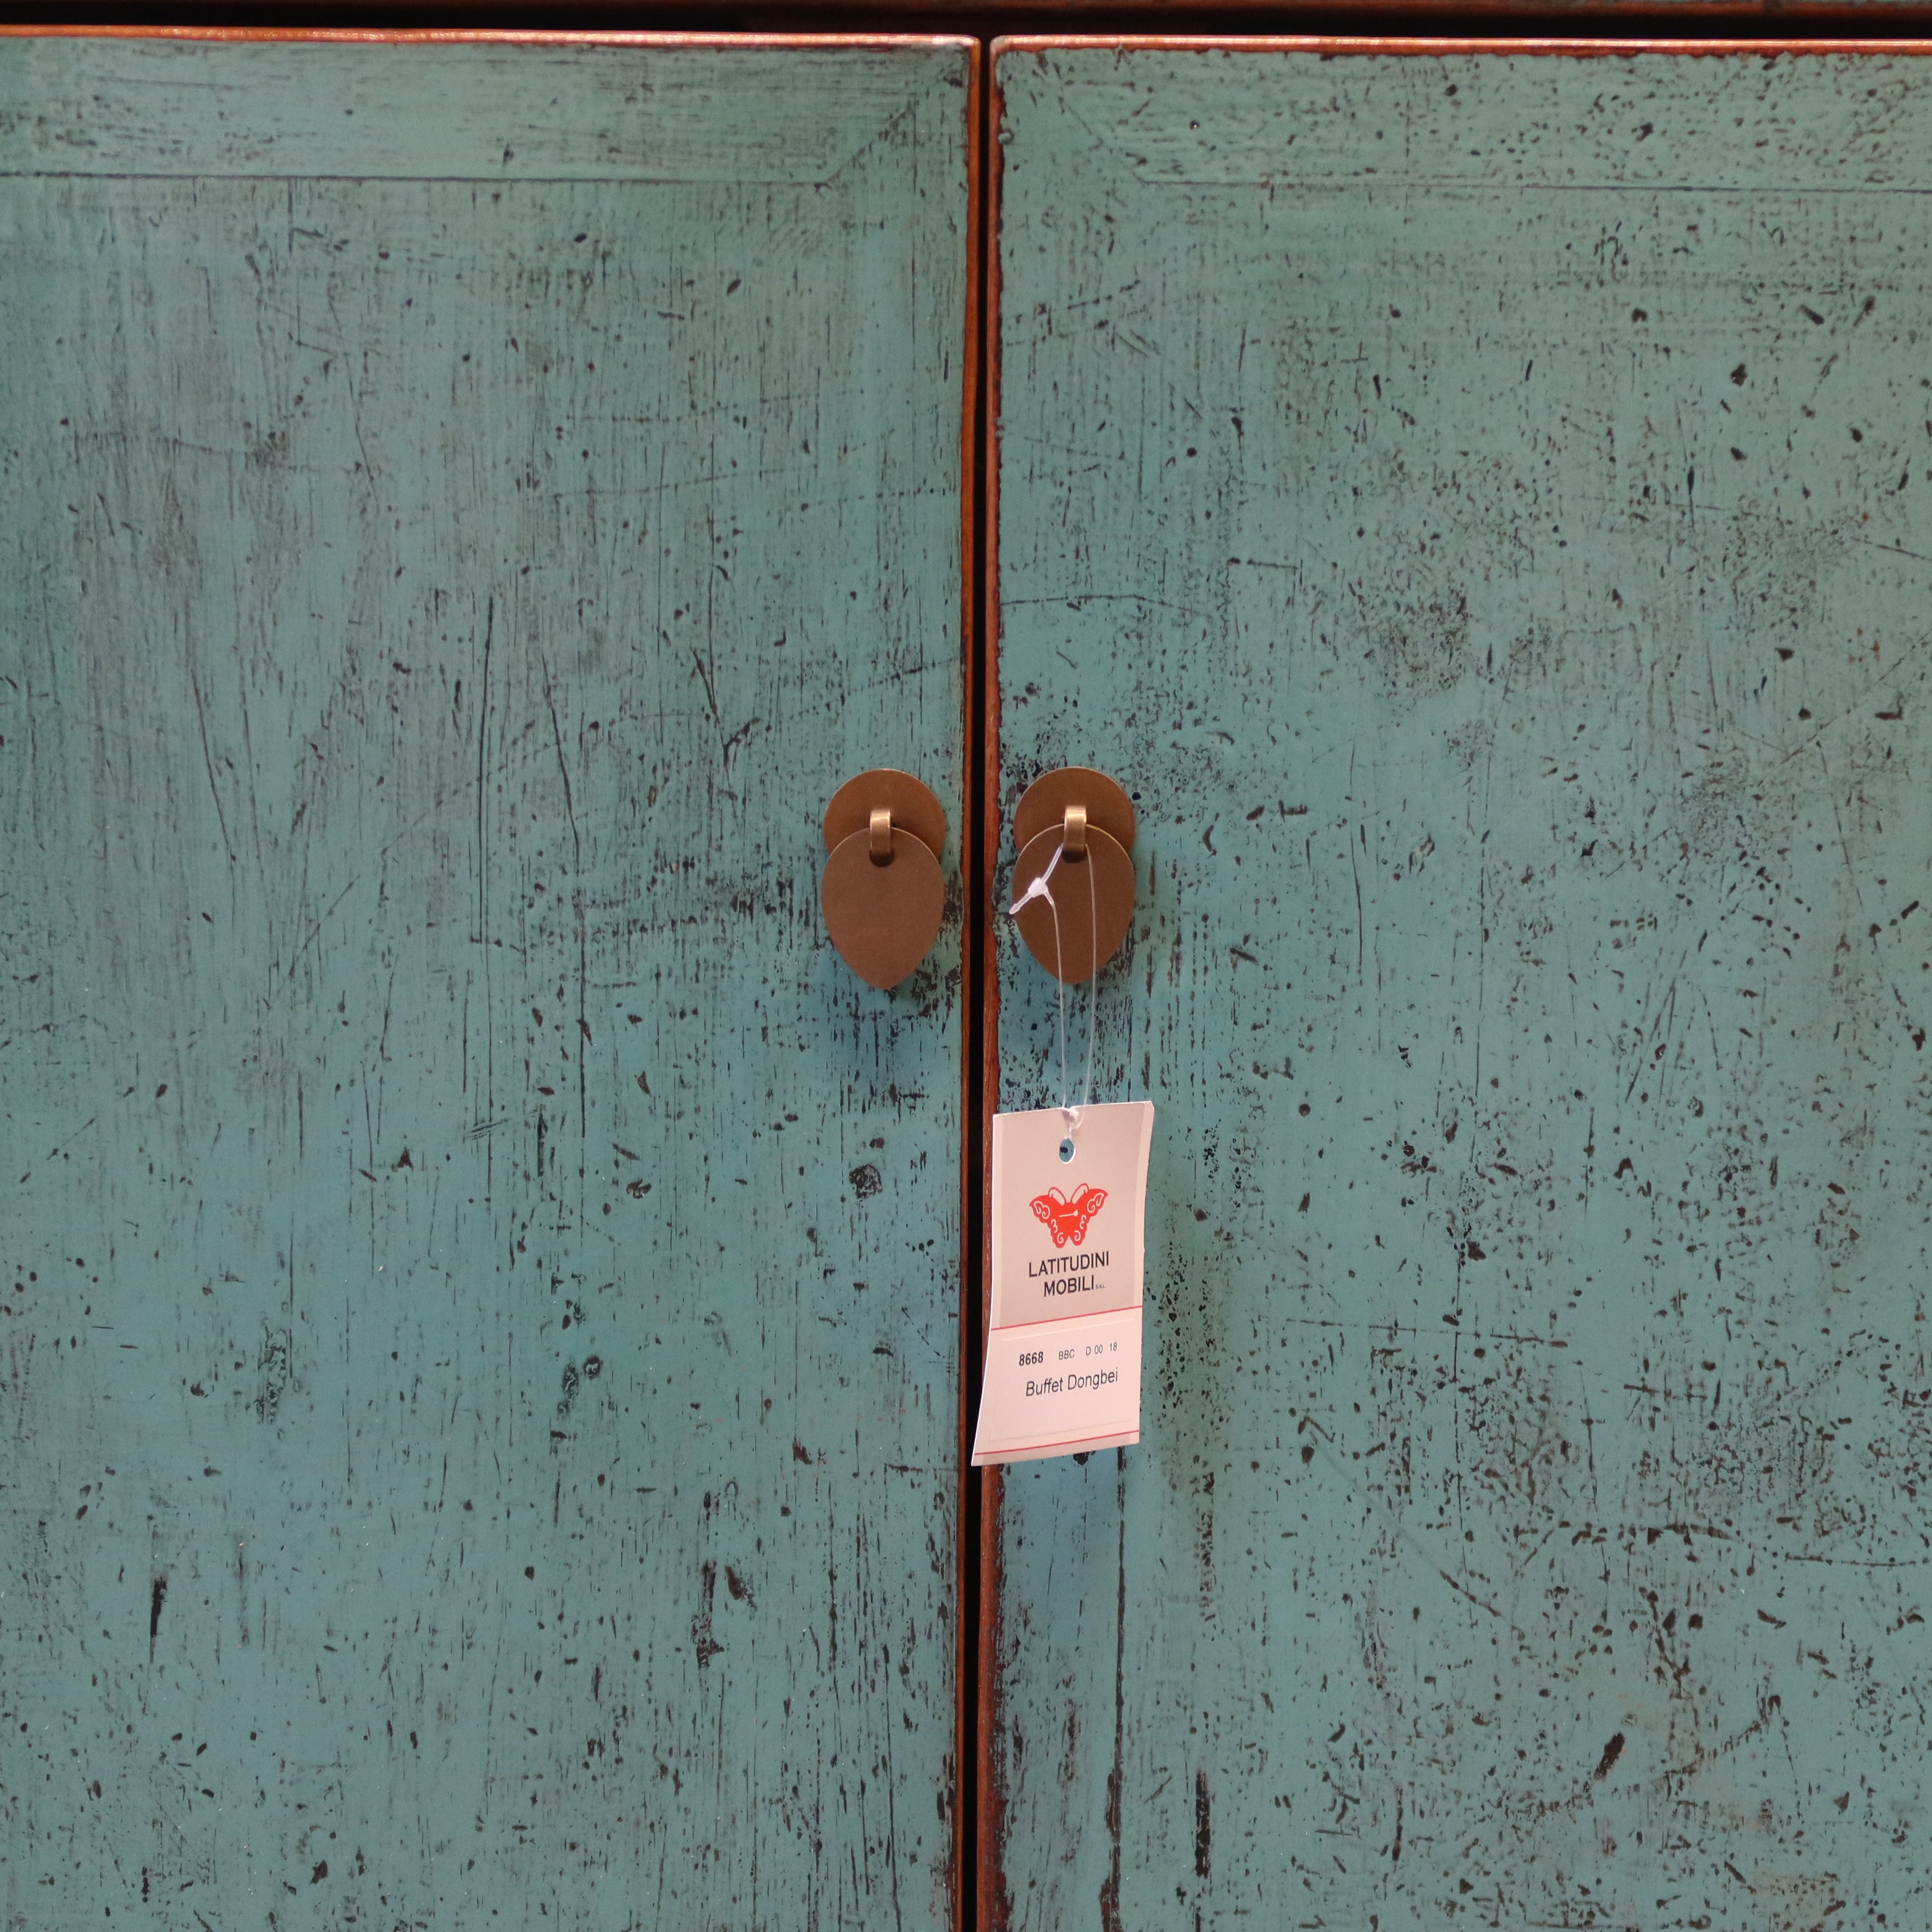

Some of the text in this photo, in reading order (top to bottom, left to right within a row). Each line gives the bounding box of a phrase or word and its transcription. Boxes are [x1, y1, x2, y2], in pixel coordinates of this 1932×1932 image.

[1028, 1250, 1109, 1277] LATITUDINI
[1044, 1275, 1094, 1297] MOBILI
[1019, 1351, 1044, 1366] 8668
[1059, 1349, 1075, 1360] BBC
[1110, 1342, 1117, 1352] 18
[1026, 1367, 1118, 1397] Buffet Dongbei
